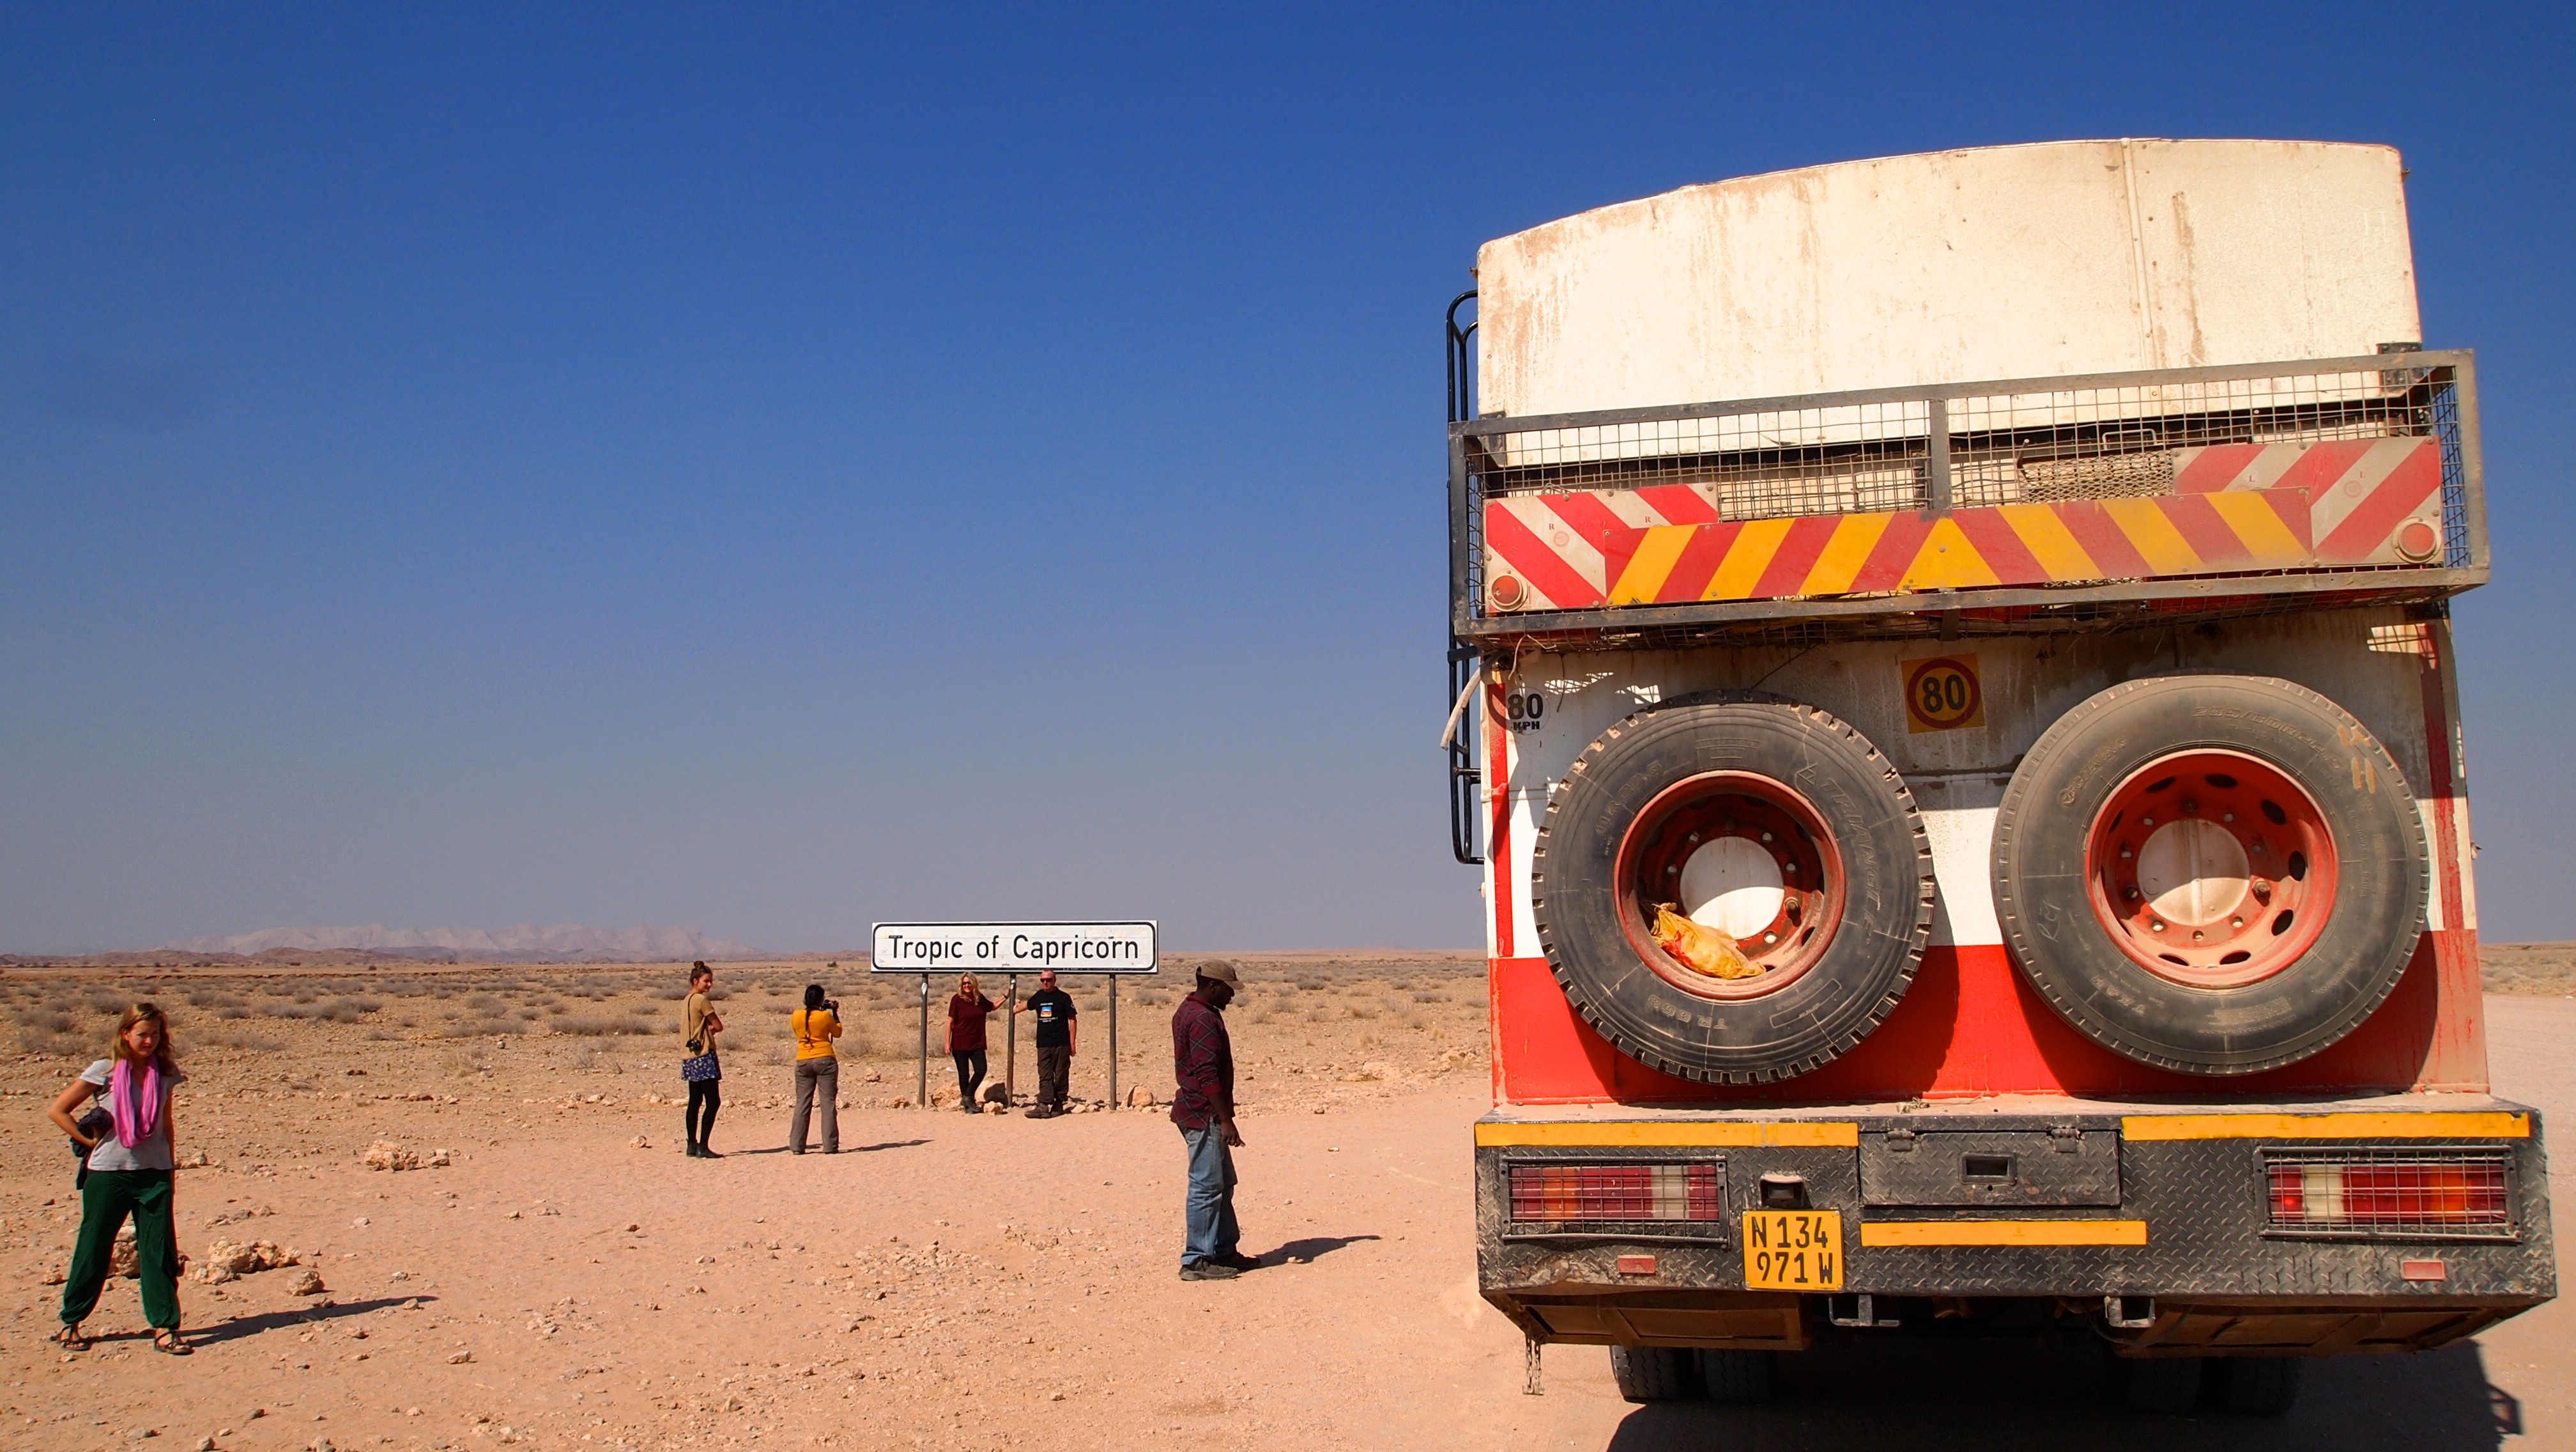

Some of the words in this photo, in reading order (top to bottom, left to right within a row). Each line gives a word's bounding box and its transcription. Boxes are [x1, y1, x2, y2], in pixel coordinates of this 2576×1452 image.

[1508, 693, 1543, 720] 80
[1922, 674, 1965, 713] 80
[1513, 721, 1540, 731] KPH
[1821, 778, 1881, 931] TRIANGLE
[889, 934, 963, 965] Tropic
[976, 934, 999, 959] of
[1013, 934, 1138, 965] Capricorn
[1777, 1216, 1828, 1249] 134
[1757, 1251, 1808, 1284] 971
[1818, 1252, 1832, 1284] W
